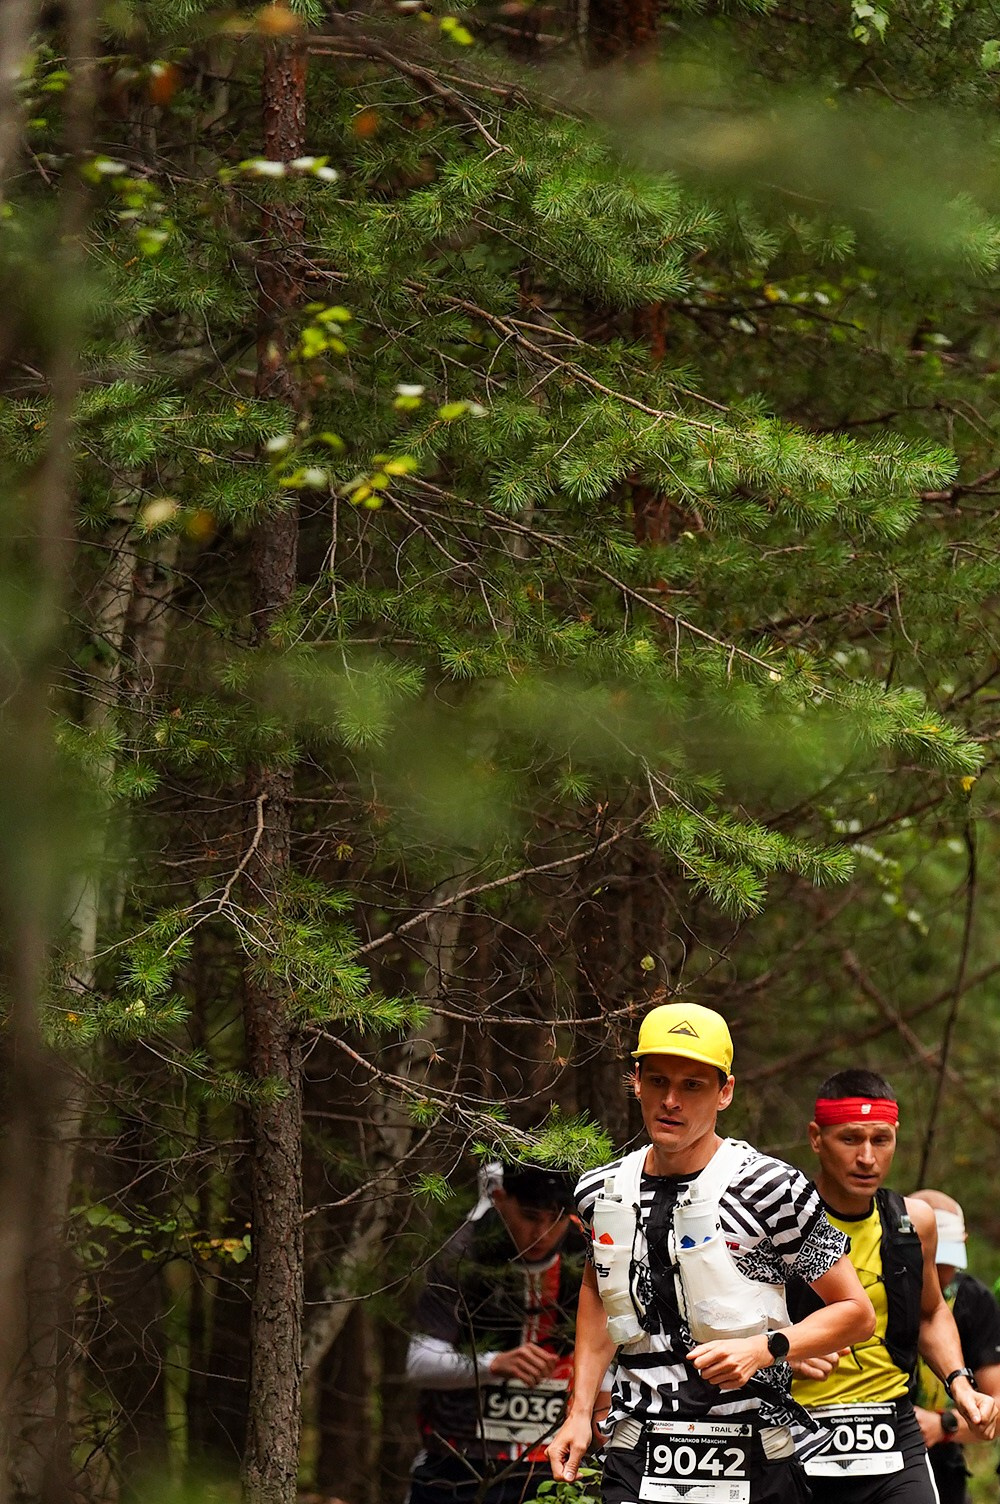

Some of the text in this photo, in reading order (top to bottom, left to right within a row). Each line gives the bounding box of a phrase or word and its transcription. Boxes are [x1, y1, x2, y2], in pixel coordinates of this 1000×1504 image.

[488, 1392, 564, 1423] 9036
[819, 1424, 895, 1454] 050
[653, 1445, 746, 1477] 9042
